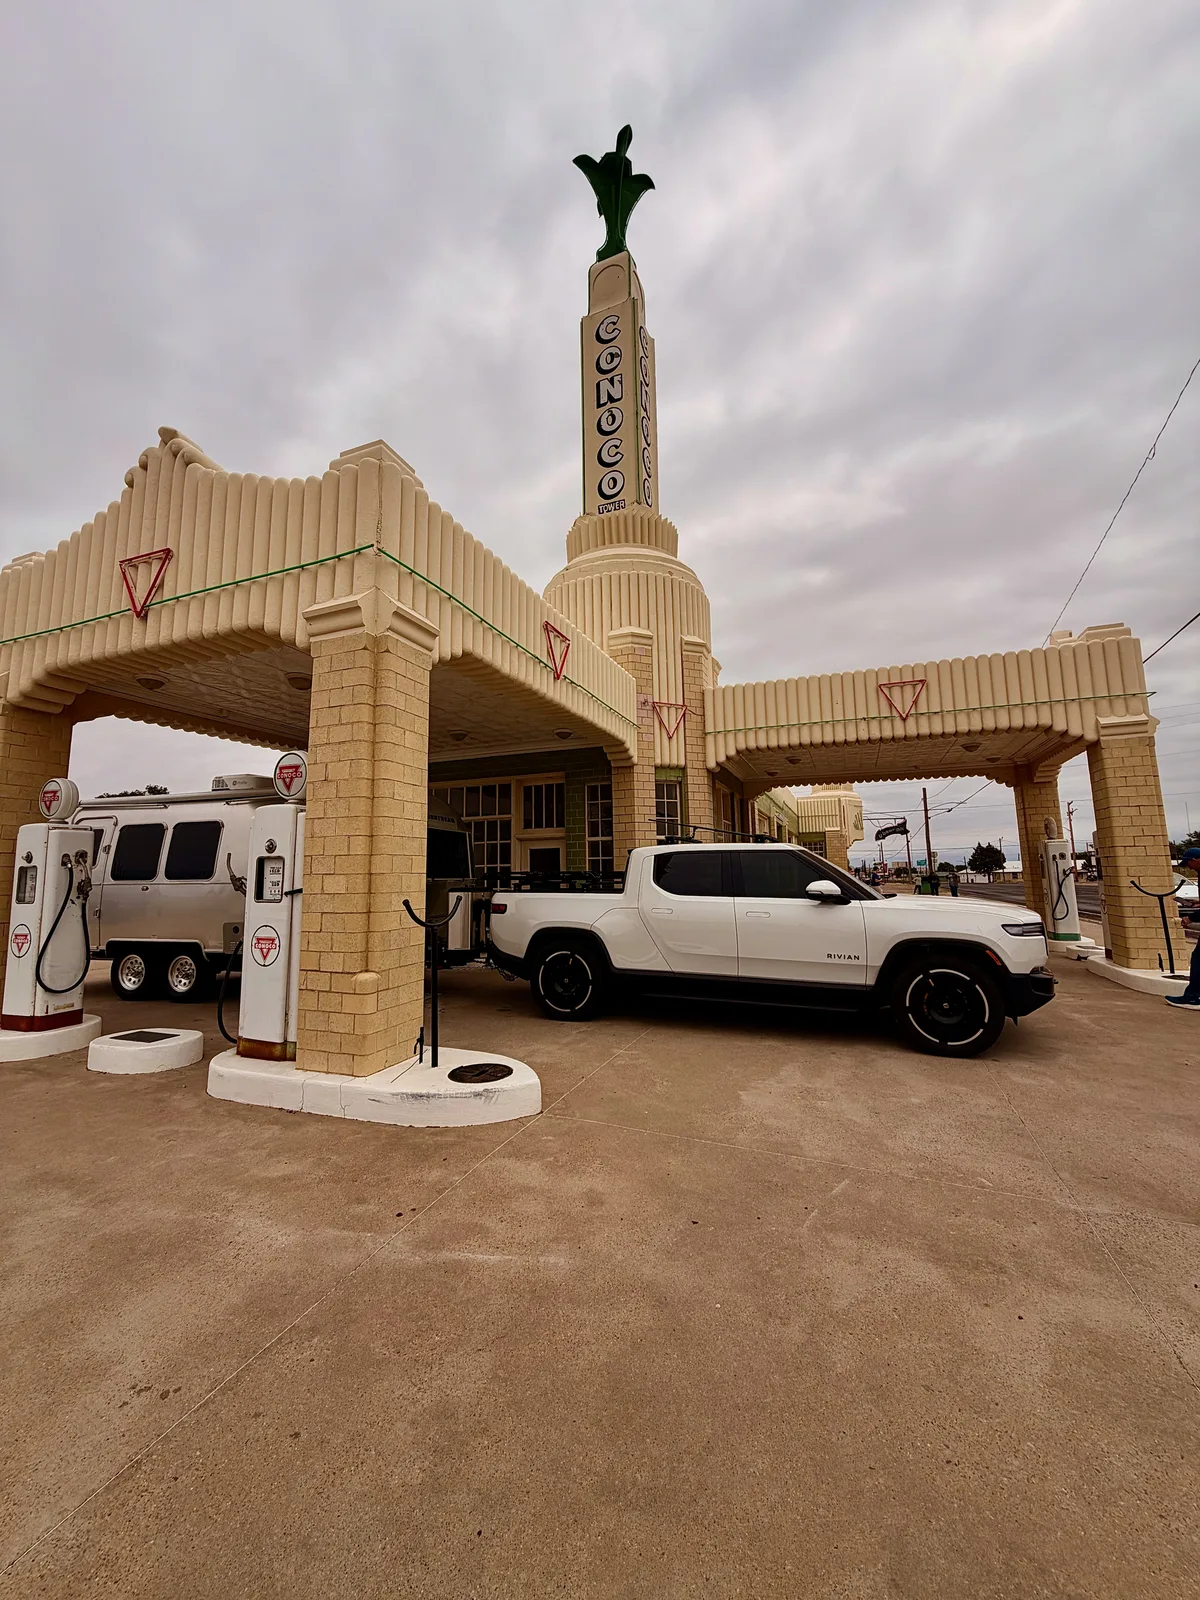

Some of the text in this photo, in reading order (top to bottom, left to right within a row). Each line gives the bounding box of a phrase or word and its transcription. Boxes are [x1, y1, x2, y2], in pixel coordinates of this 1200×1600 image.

[595, 314, 625, 500] CONOCO
[598, 500, 625, 514] TOWER
[826, 953, 860, 961] RIVIAN
